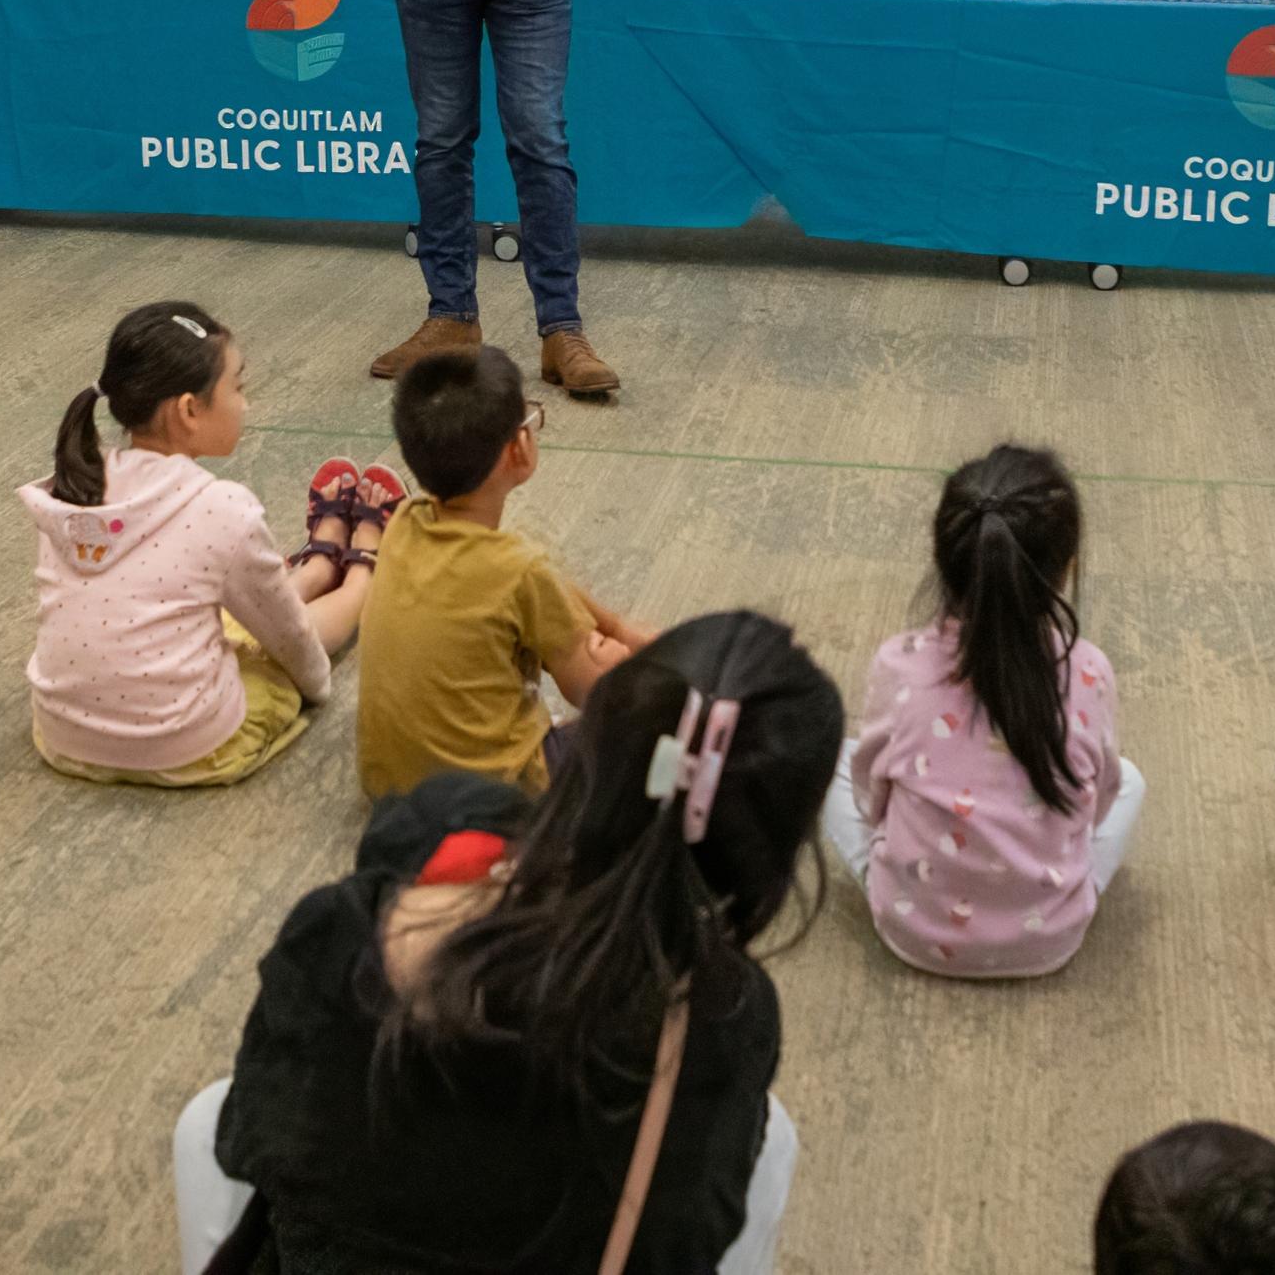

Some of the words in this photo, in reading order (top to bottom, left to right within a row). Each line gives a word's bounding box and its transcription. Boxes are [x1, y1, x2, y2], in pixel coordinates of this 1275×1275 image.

[217, 107, 383, 133] COQUITLAM
[141, 136, 282, 171] PUBLIC
[296, 140, 418, 175] LIBRA
[1095, 182, 1251, 225] PUBLIC
